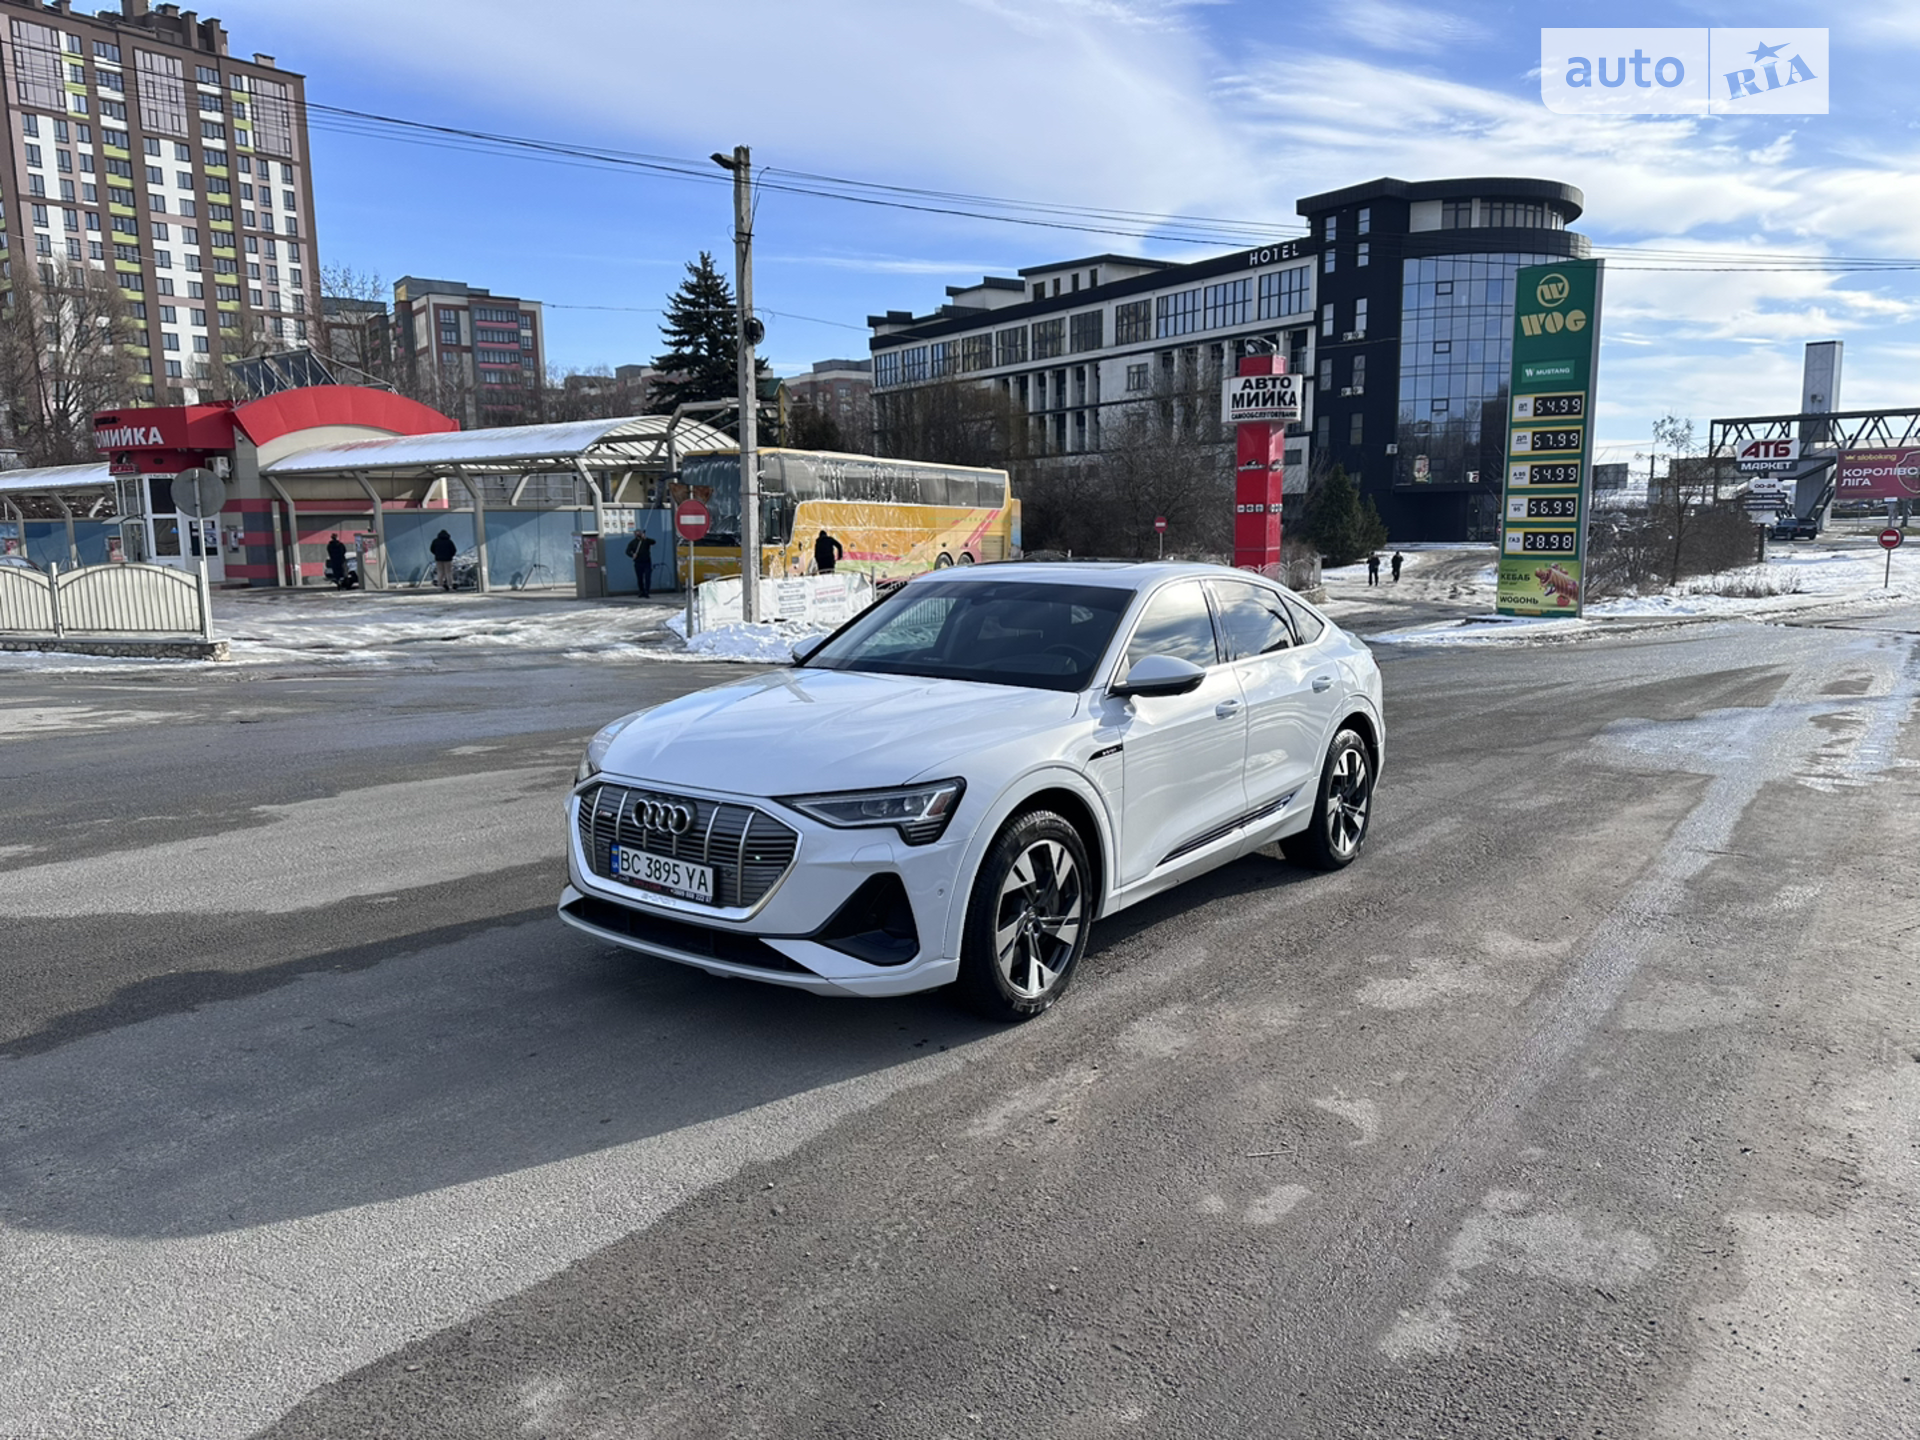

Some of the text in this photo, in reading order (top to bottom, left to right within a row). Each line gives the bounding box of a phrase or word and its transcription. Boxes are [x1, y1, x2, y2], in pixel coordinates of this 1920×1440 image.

[1249, 243, 1299, 266] HOTEL
[1520, 309, 1587, 336] WOG
[1536, 367, 1570, 376] MUSTANG
[1241, 376, 1292, 391] АВТО
[1231, 390, 1297, 408] МИЙКА
[1535, 398, 1581, 414] 54.99
[1533, 432, 1579, 448] 57.99
[1741, 440, 1793, 459] АТБ
[1741, 461, 1792, 471] МАРКЕТ
[1531, 467, 1577, 481] 54.99
[1841, 478, 1871, 487] ЛІГА
[1530, 501, 1574, 514] 56.99
[1525, 534, 1572, 549] 28.98
[1501, 573, 1530, 582] КЕБАБ
[620, 848, 641, 875] BC
[645, 856, 681, 885] 3895
[685, 865, 709, 893] YA
